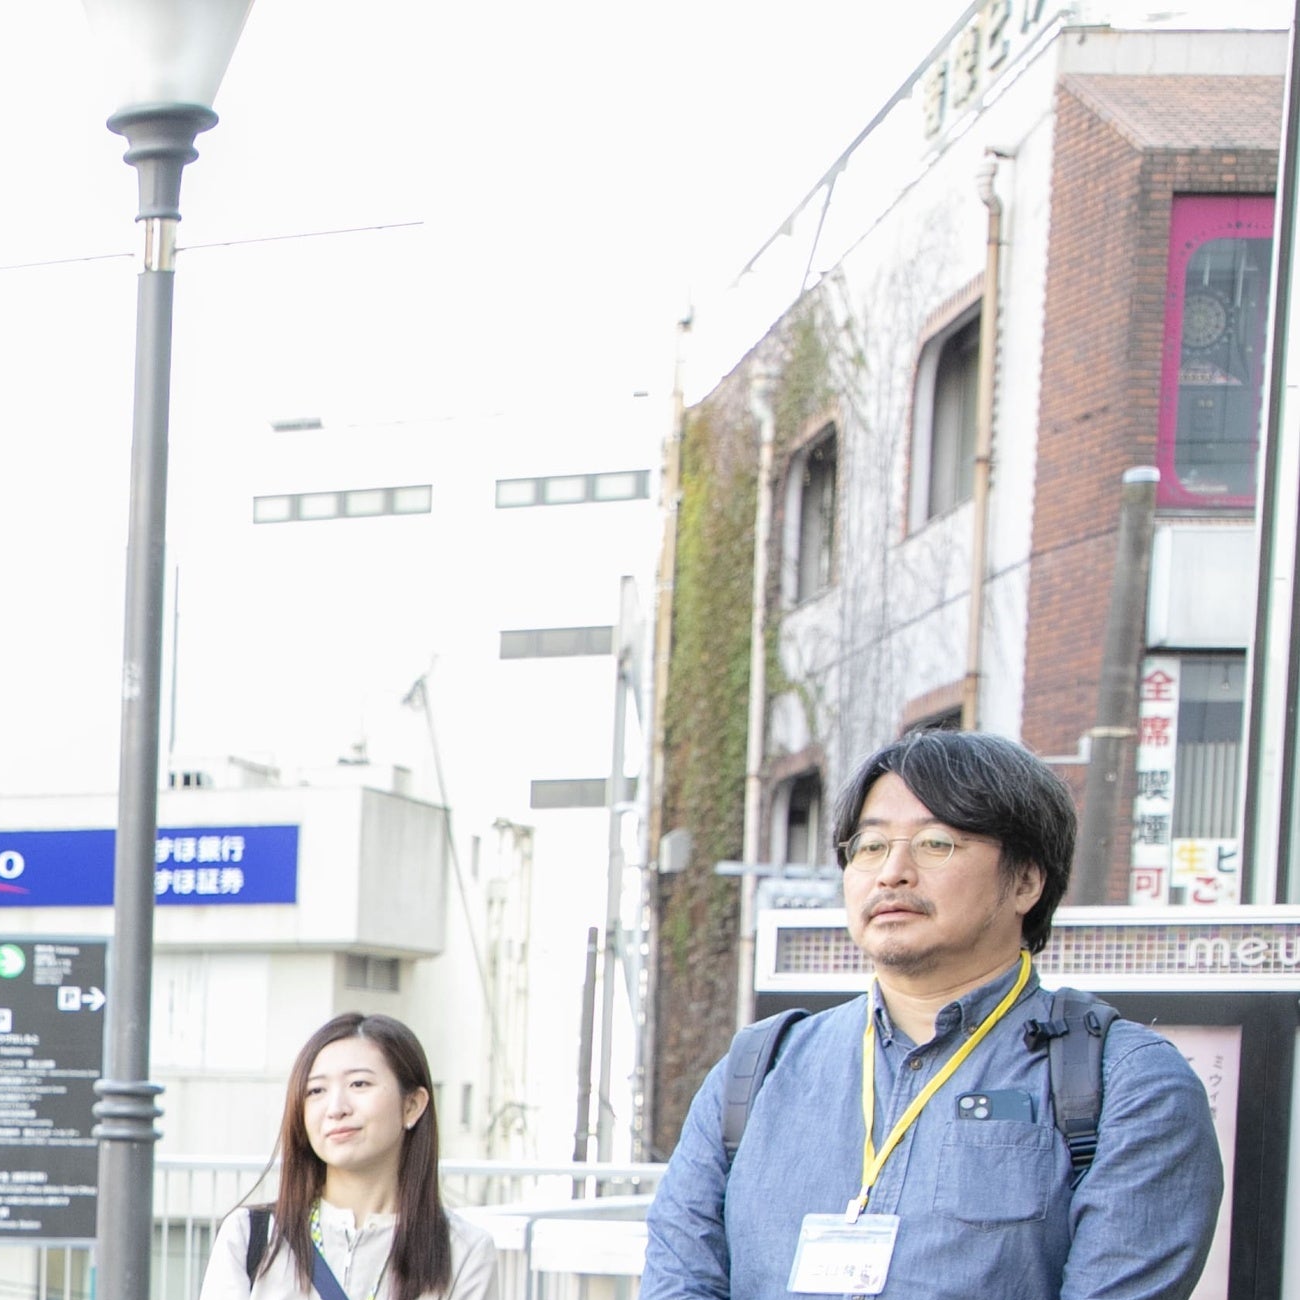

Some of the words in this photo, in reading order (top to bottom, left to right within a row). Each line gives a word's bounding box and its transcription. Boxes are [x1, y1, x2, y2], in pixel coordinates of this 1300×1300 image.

[1131, 668, 1176, 900] 全席喫煙可
